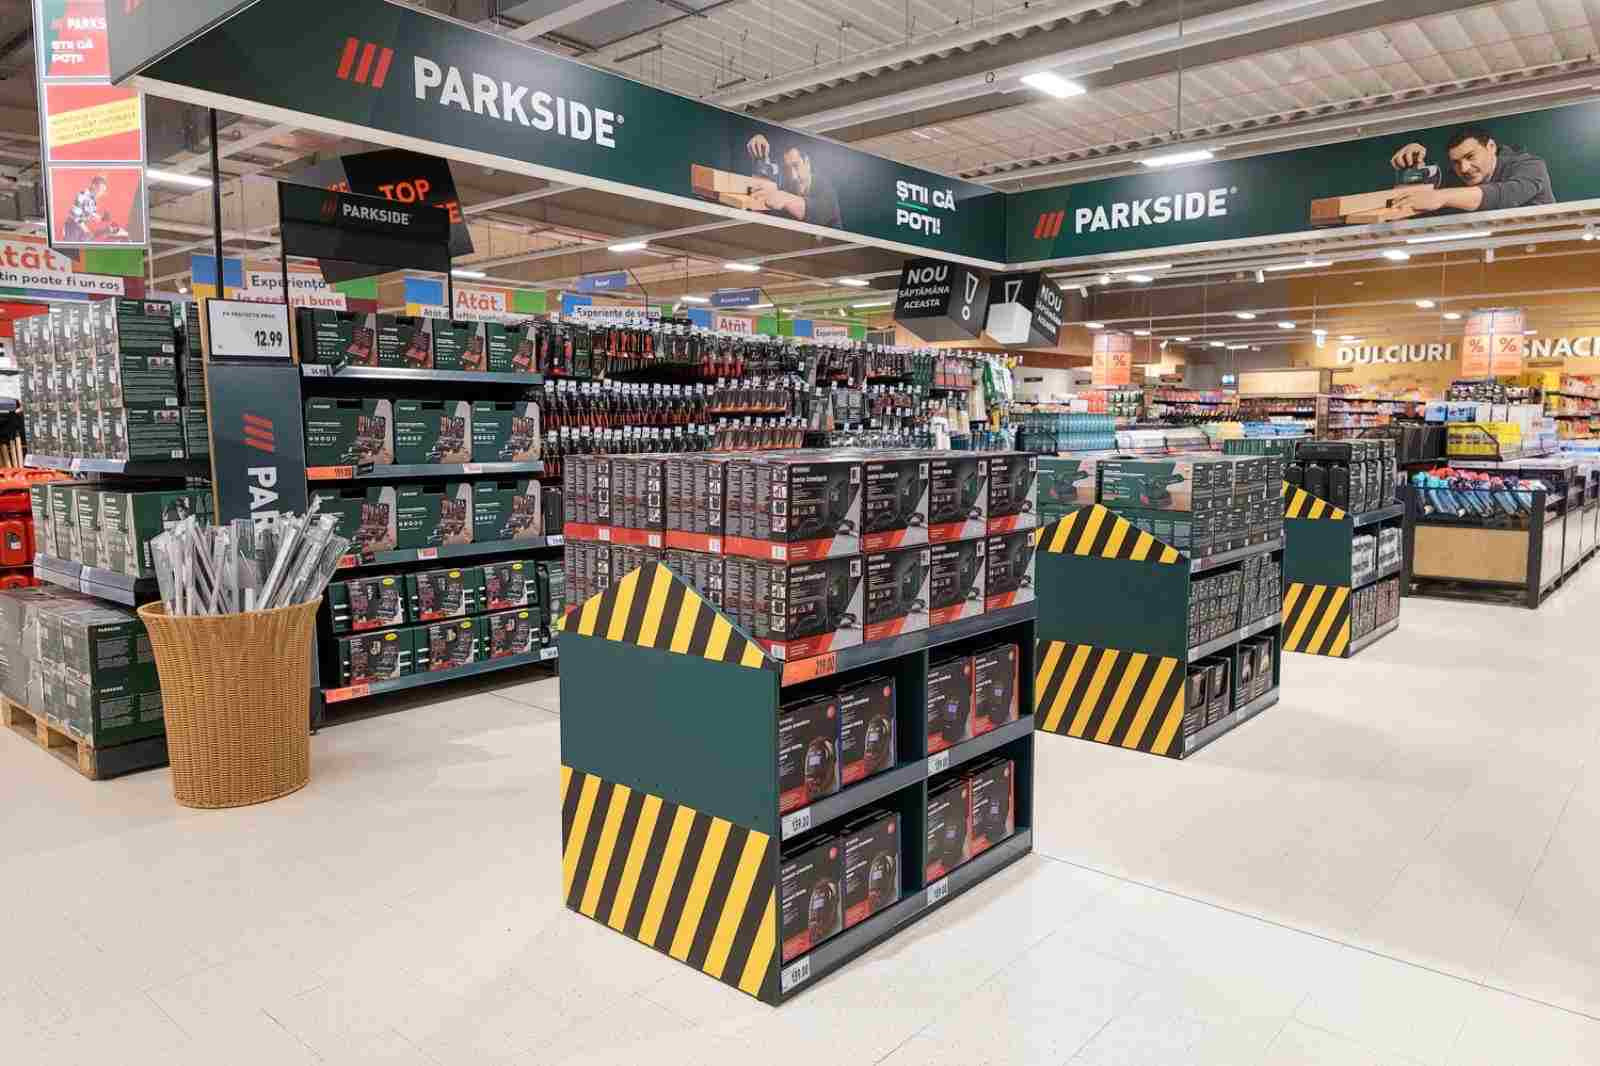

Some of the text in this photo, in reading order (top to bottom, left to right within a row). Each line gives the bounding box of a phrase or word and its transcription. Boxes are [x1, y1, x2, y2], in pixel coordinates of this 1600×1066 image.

[377, 178, 431, 204] TOP
[342, 203, 410, 226] PARKSIDE
[22, 273, 62, 284] poate
[80, 277, 96, 288] un
[906, 265, 949, 286] NOU
[1040, 284, 1063, 312] NOU
[254, 329, 283, 347] 12.99
[1337, 342, 1453, 366] DULCIURI
